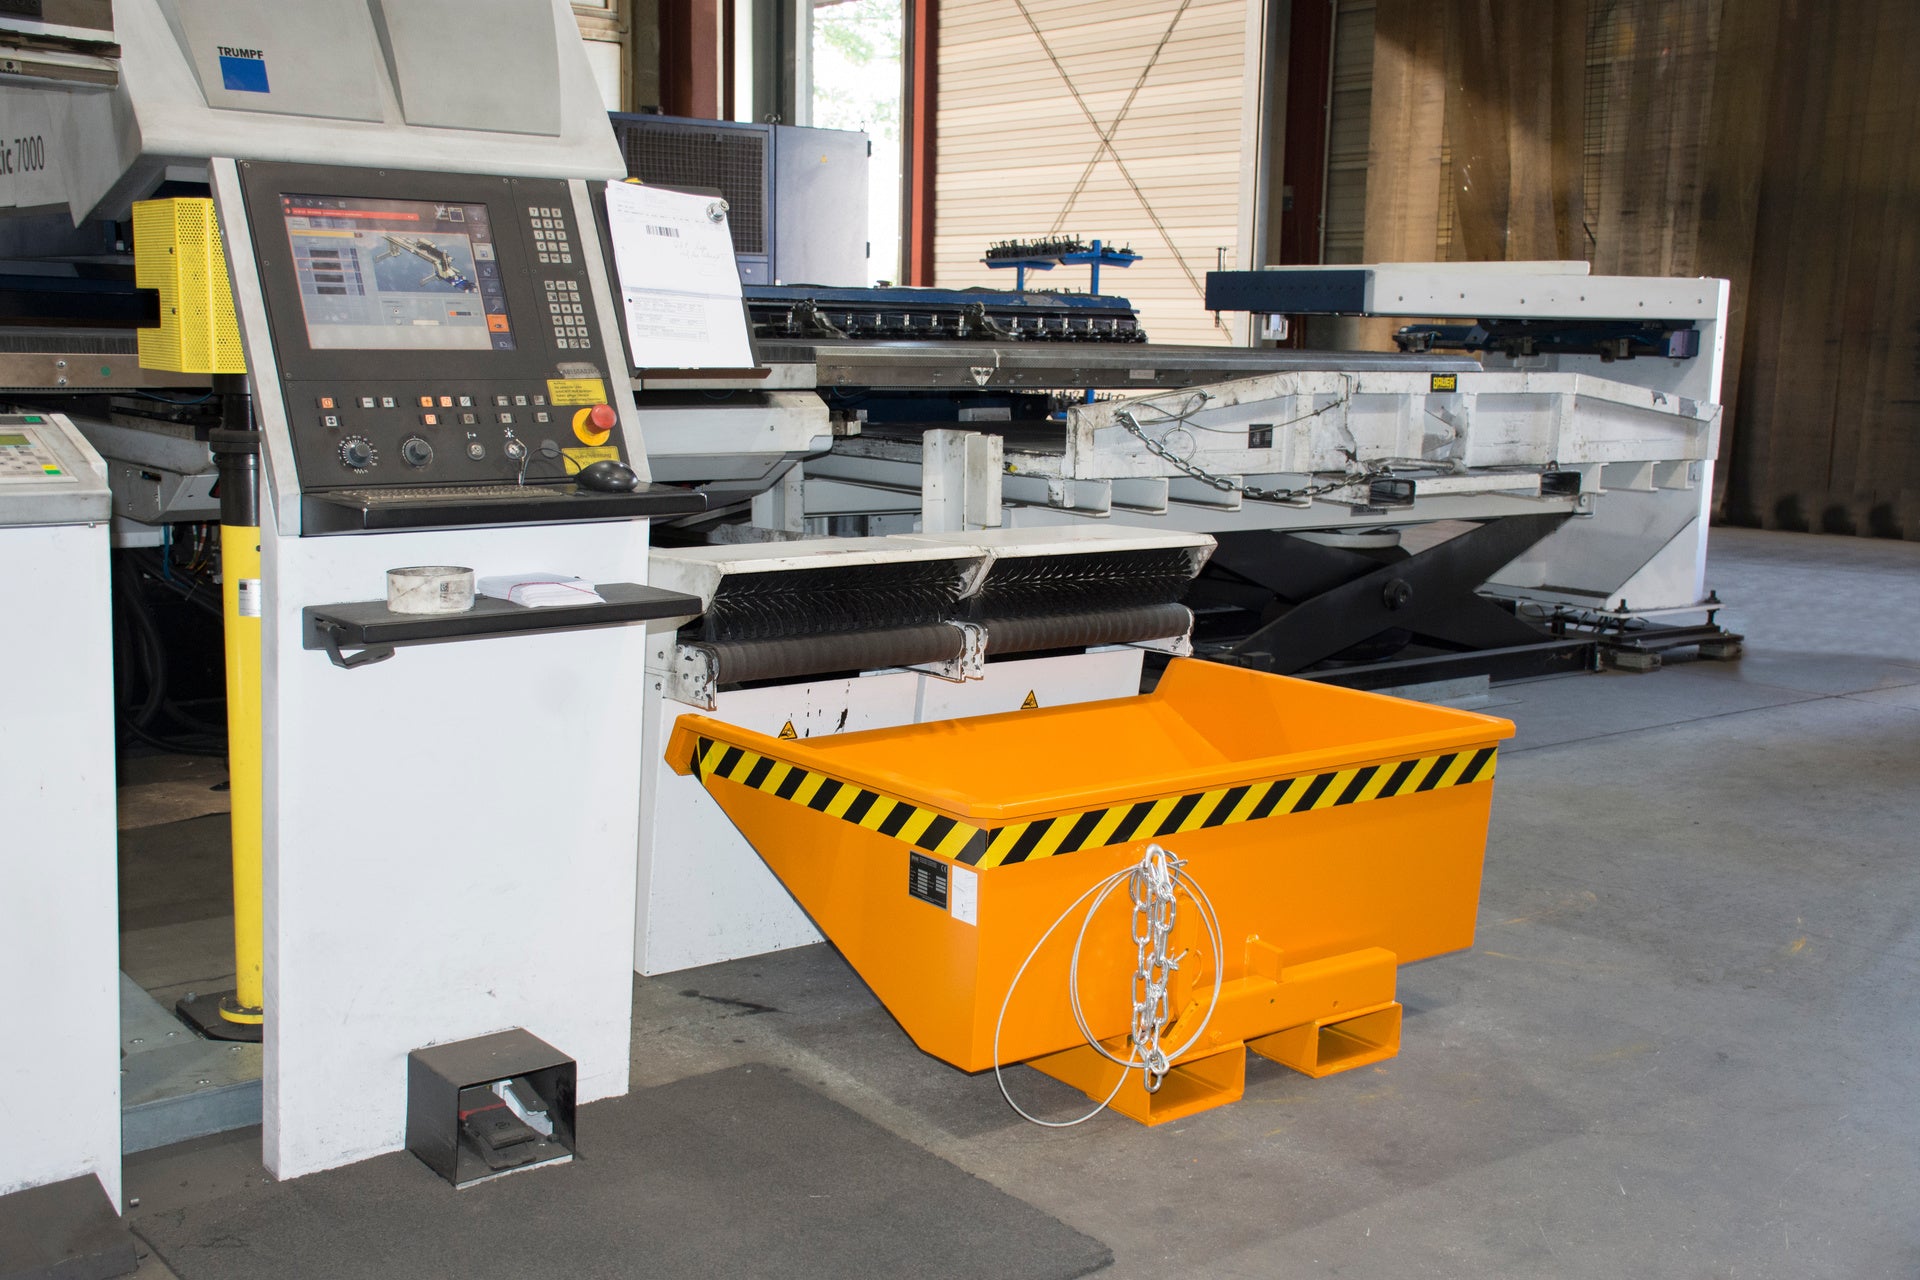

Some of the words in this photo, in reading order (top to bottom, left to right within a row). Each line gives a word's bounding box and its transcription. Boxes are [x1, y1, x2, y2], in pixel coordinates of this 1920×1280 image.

[217, 46, 264, 60] TRUMPF
[0, 139, 13, 175] ic
[14, 135, 45, 172] 7000
